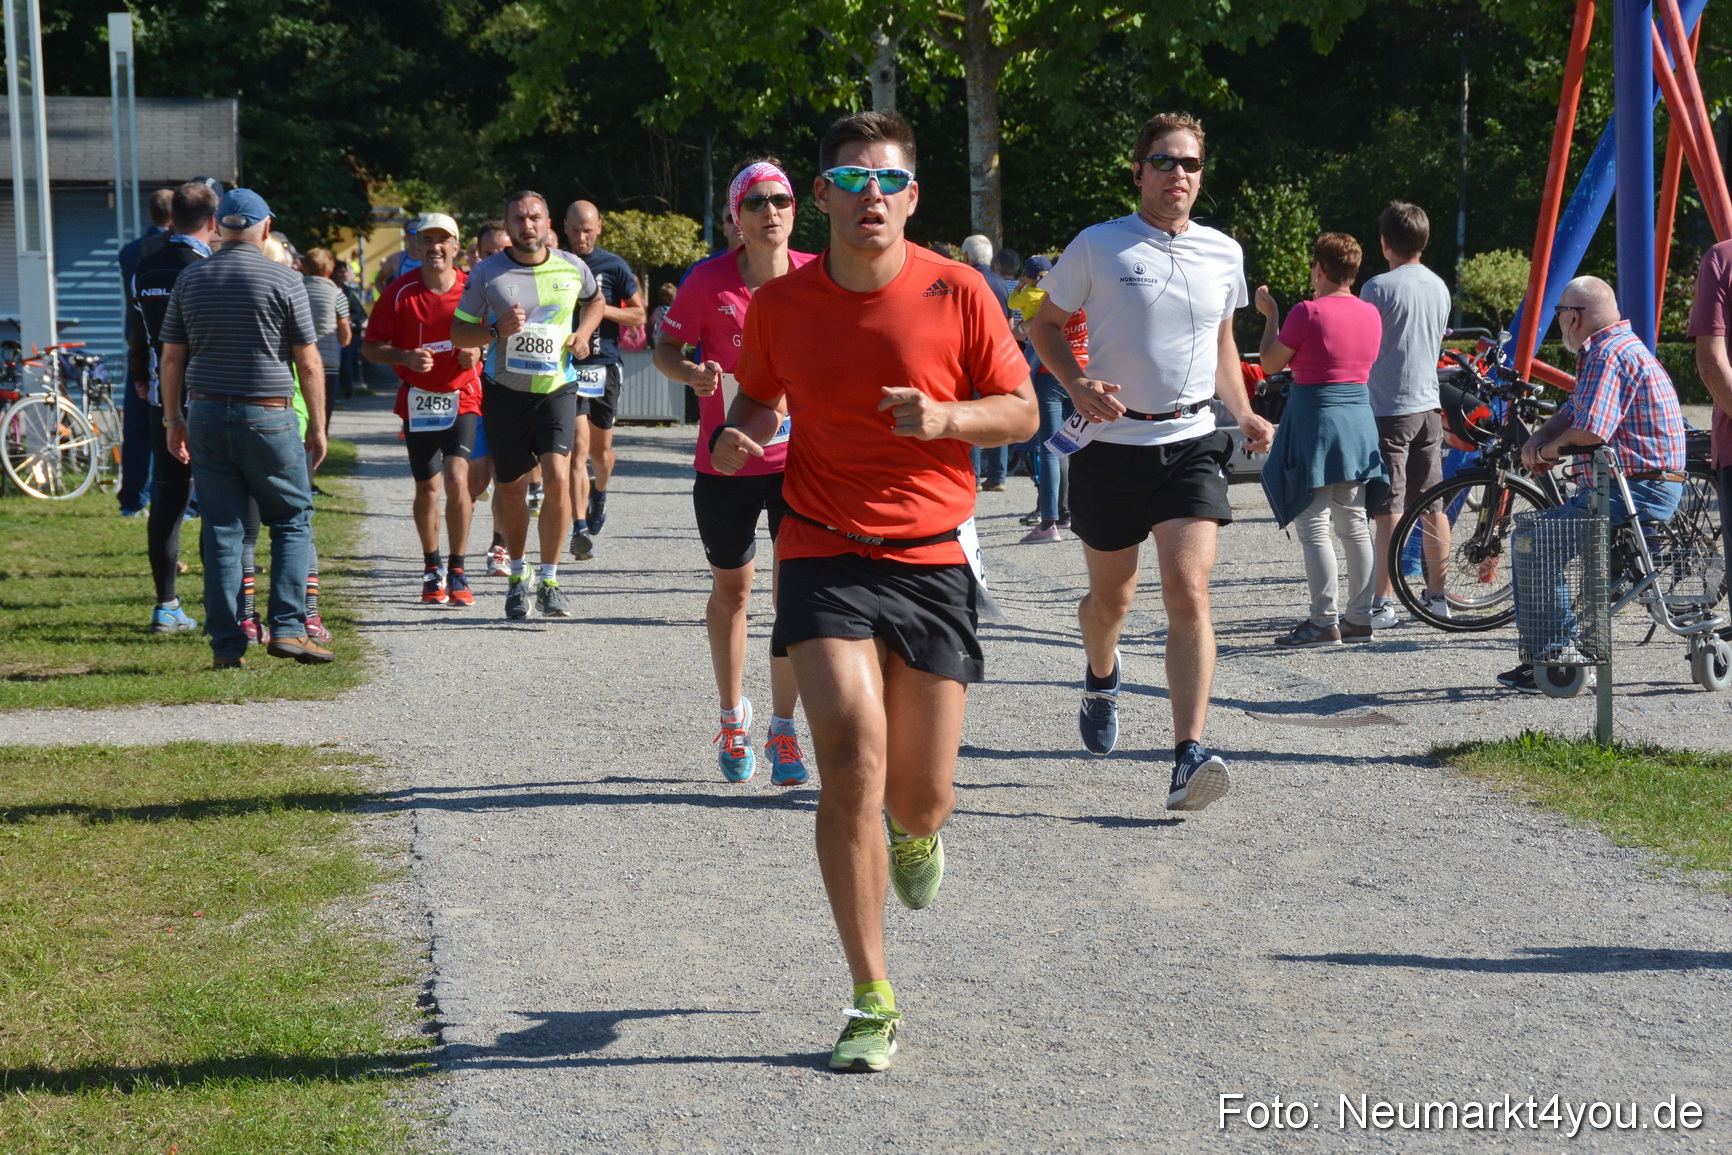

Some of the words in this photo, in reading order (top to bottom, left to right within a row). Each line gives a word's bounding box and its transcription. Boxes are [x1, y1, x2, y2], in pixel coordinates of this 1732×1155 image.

[1120, 276, 1158, 284] NÜRNBERGER
[922, 288, 953, 297] adidas
[515, 336, 553, 354] 2888
[415, 395, 452, 411] 2458
